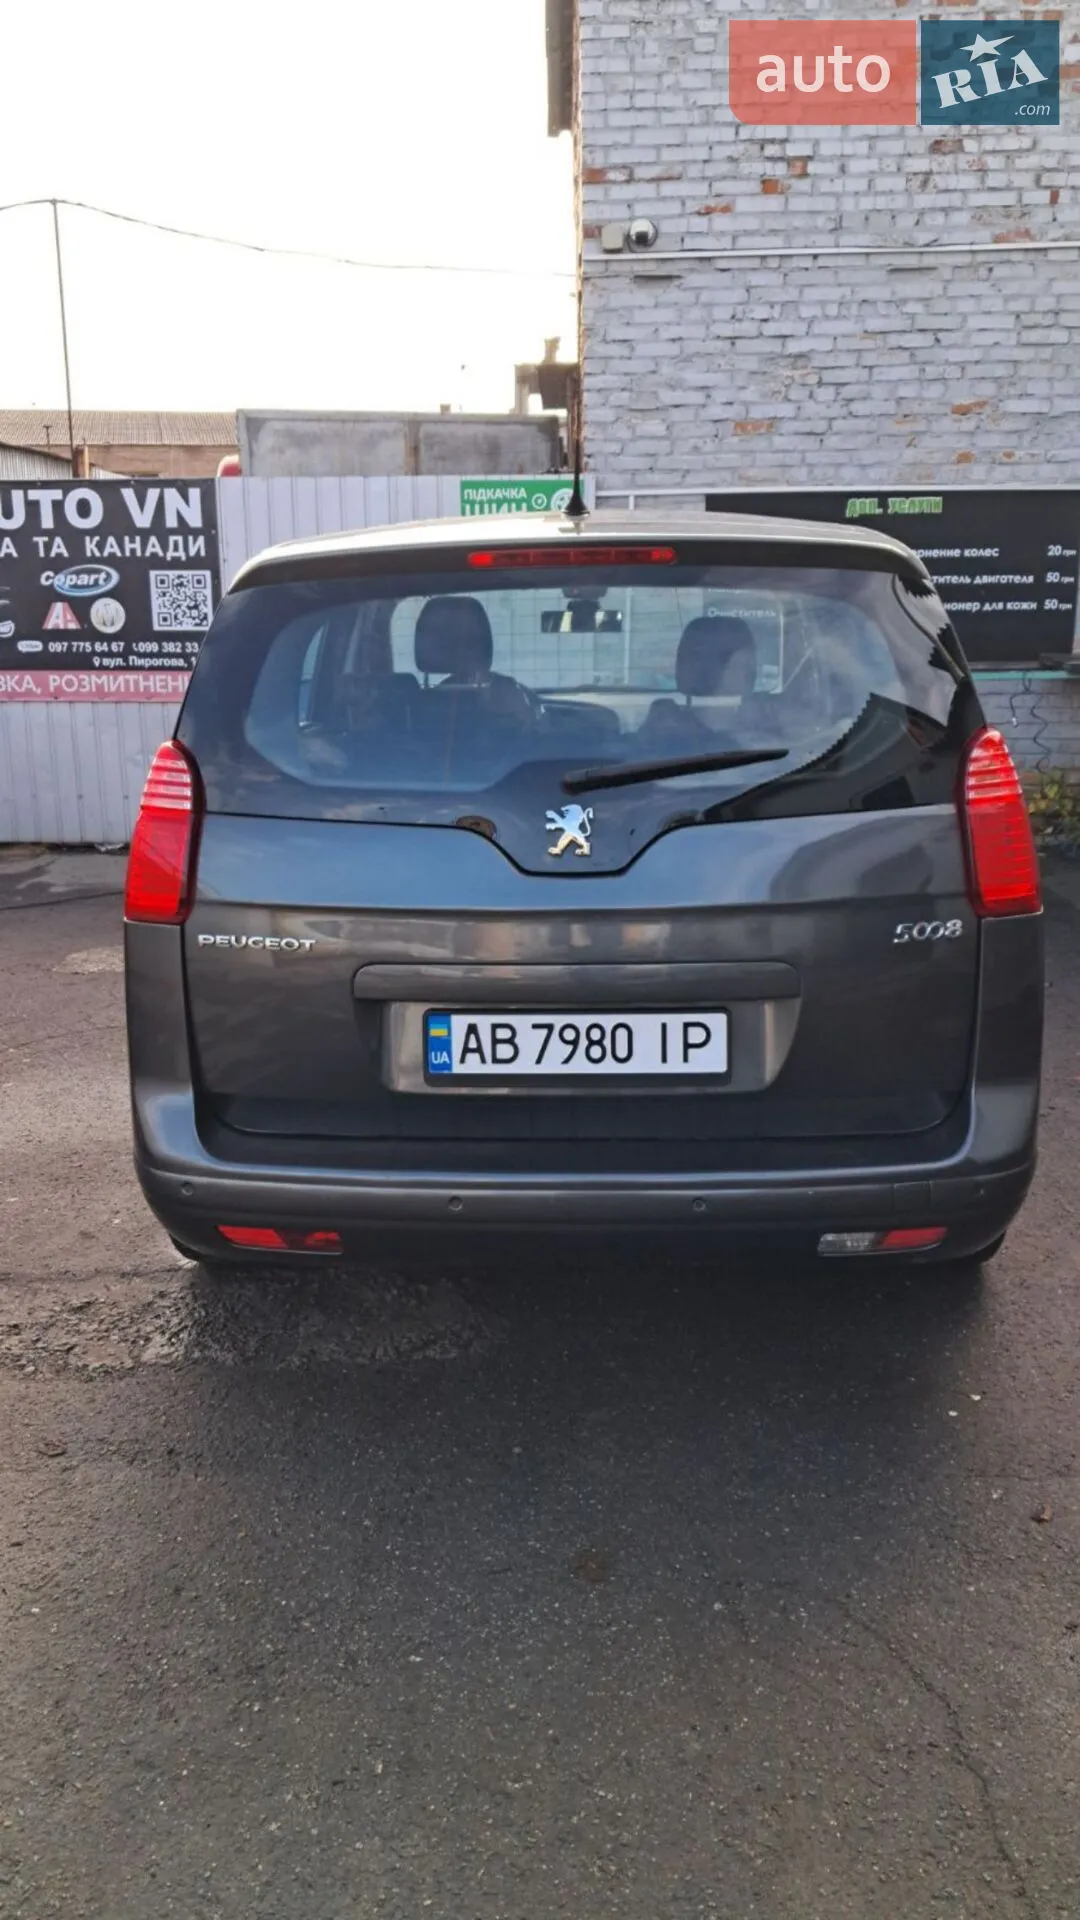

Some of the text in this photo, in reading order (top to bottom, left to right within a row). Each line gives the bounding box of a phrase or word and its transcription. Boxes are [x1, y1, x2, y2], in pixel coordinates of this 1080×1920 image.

[464, 488, 527, 501] ПІДКАЧКА
[120, 488, 203, 528] VN
[33, 536, 69, 557] ТА
[85, 535, 206, 561] КАНАДИ
[914, 548, 961, 558] рнение
[964, 548, 1000, 557] колес
[1047, 545, 1062, 556] 20
[40, 570, 107, 588] Copart
[931, 575, 971, 584] титель
[974, 575, 1034, 585] двигателя
[1046, 572, 1060, 583] 50
[983, 603, 1003, 611] для
[1006, 602, 1038, 611] кожи
[1044, 599, 1058, 610] 50
[48, 642, 67, 653] 097
[71, 642, 92, 653] 775
[111, 642, 125, 652] 67
[139, 642, 199, 653] 099 382 33
[103, 659, 126, 667] вул.
[129, 656, 188, 668] Пирогова,
[893, 918, 963, 943] 5008
[198, 934, 316, 951] PEUGEOT
[459, 1021, 711, 1065] AB 7980 IP
[431, 1050, 450, 1064] UA
